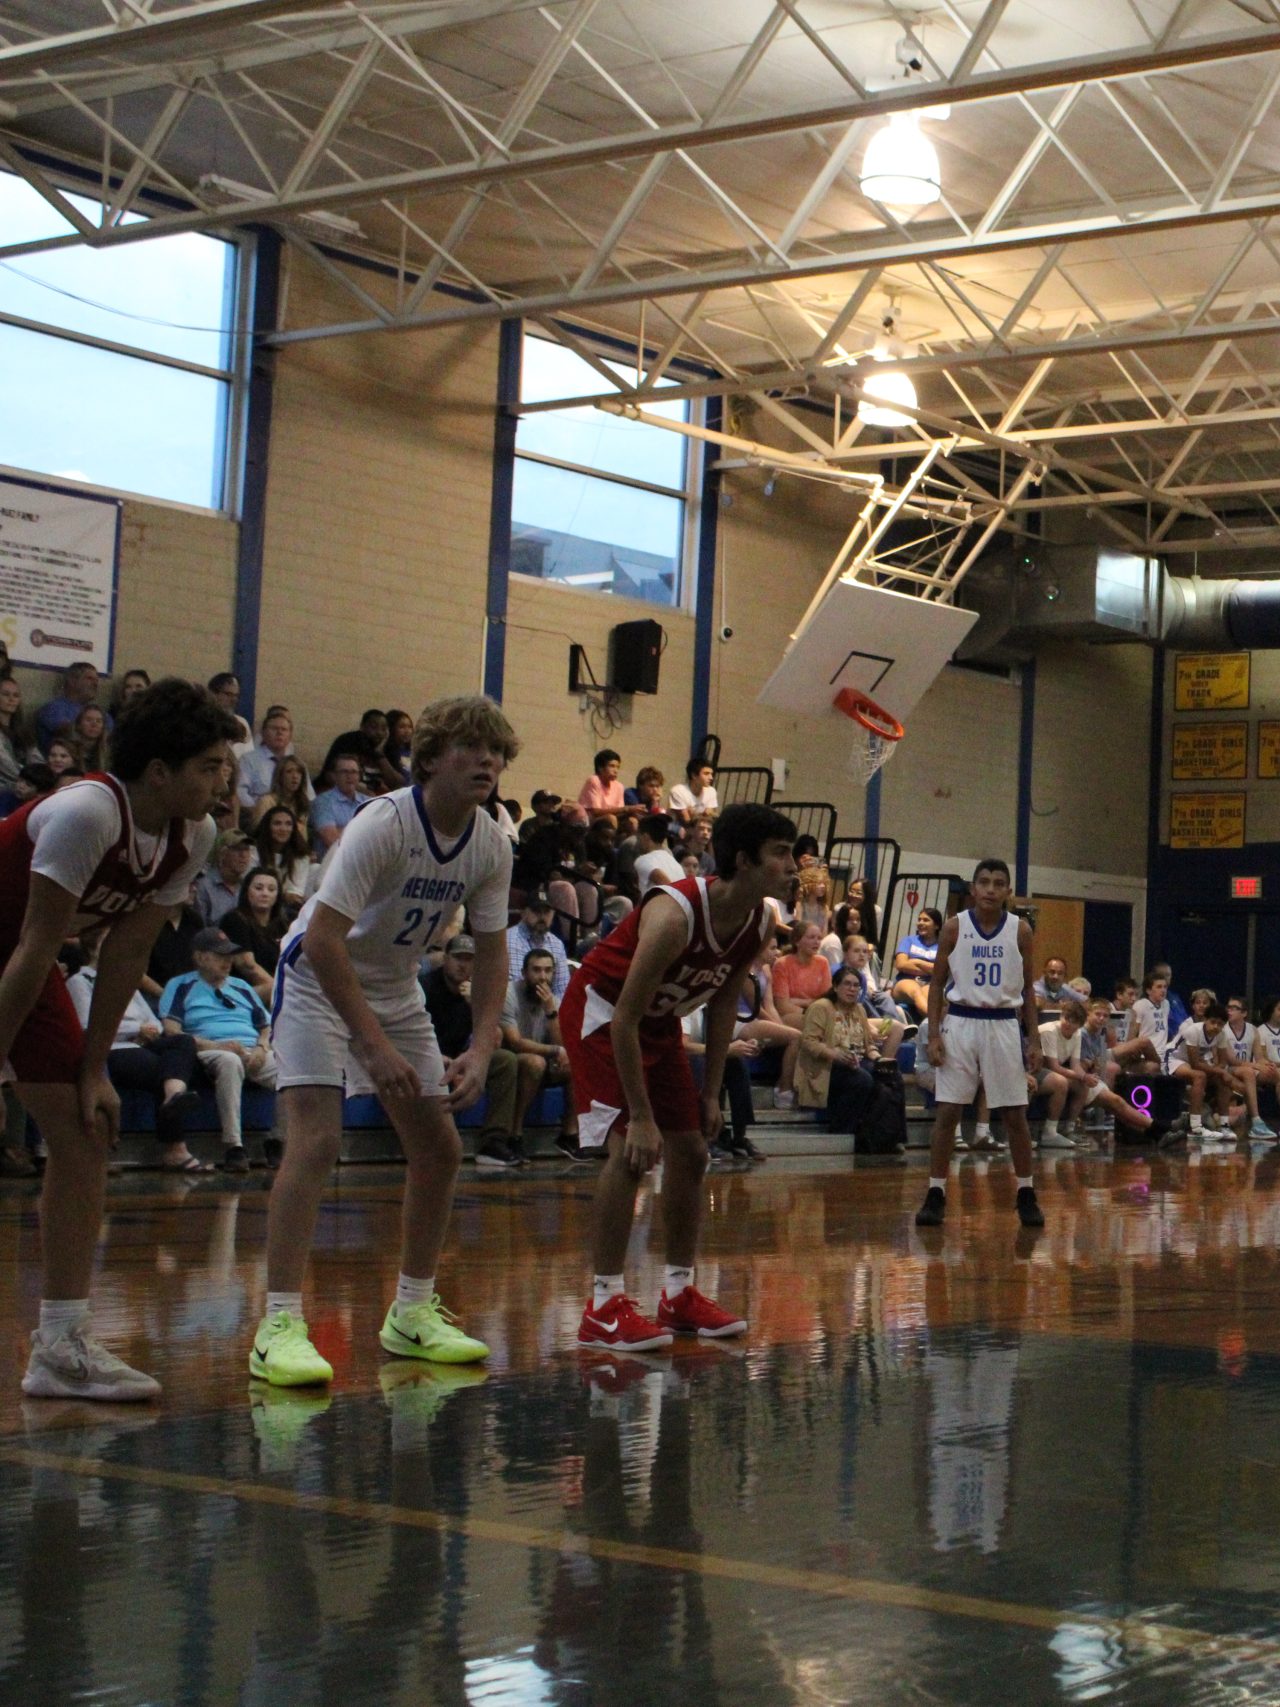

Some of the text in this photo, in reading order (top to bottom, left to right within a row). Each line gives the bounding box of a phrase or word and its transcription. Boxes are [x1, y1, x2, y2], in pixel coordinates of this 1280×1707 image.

[401, 877, 465, 902] HEIGHTS
[393, 906, 443, 946] 21
[971, 945, 1004, 958] MULES
[973, 962, 1002, 987] 30
